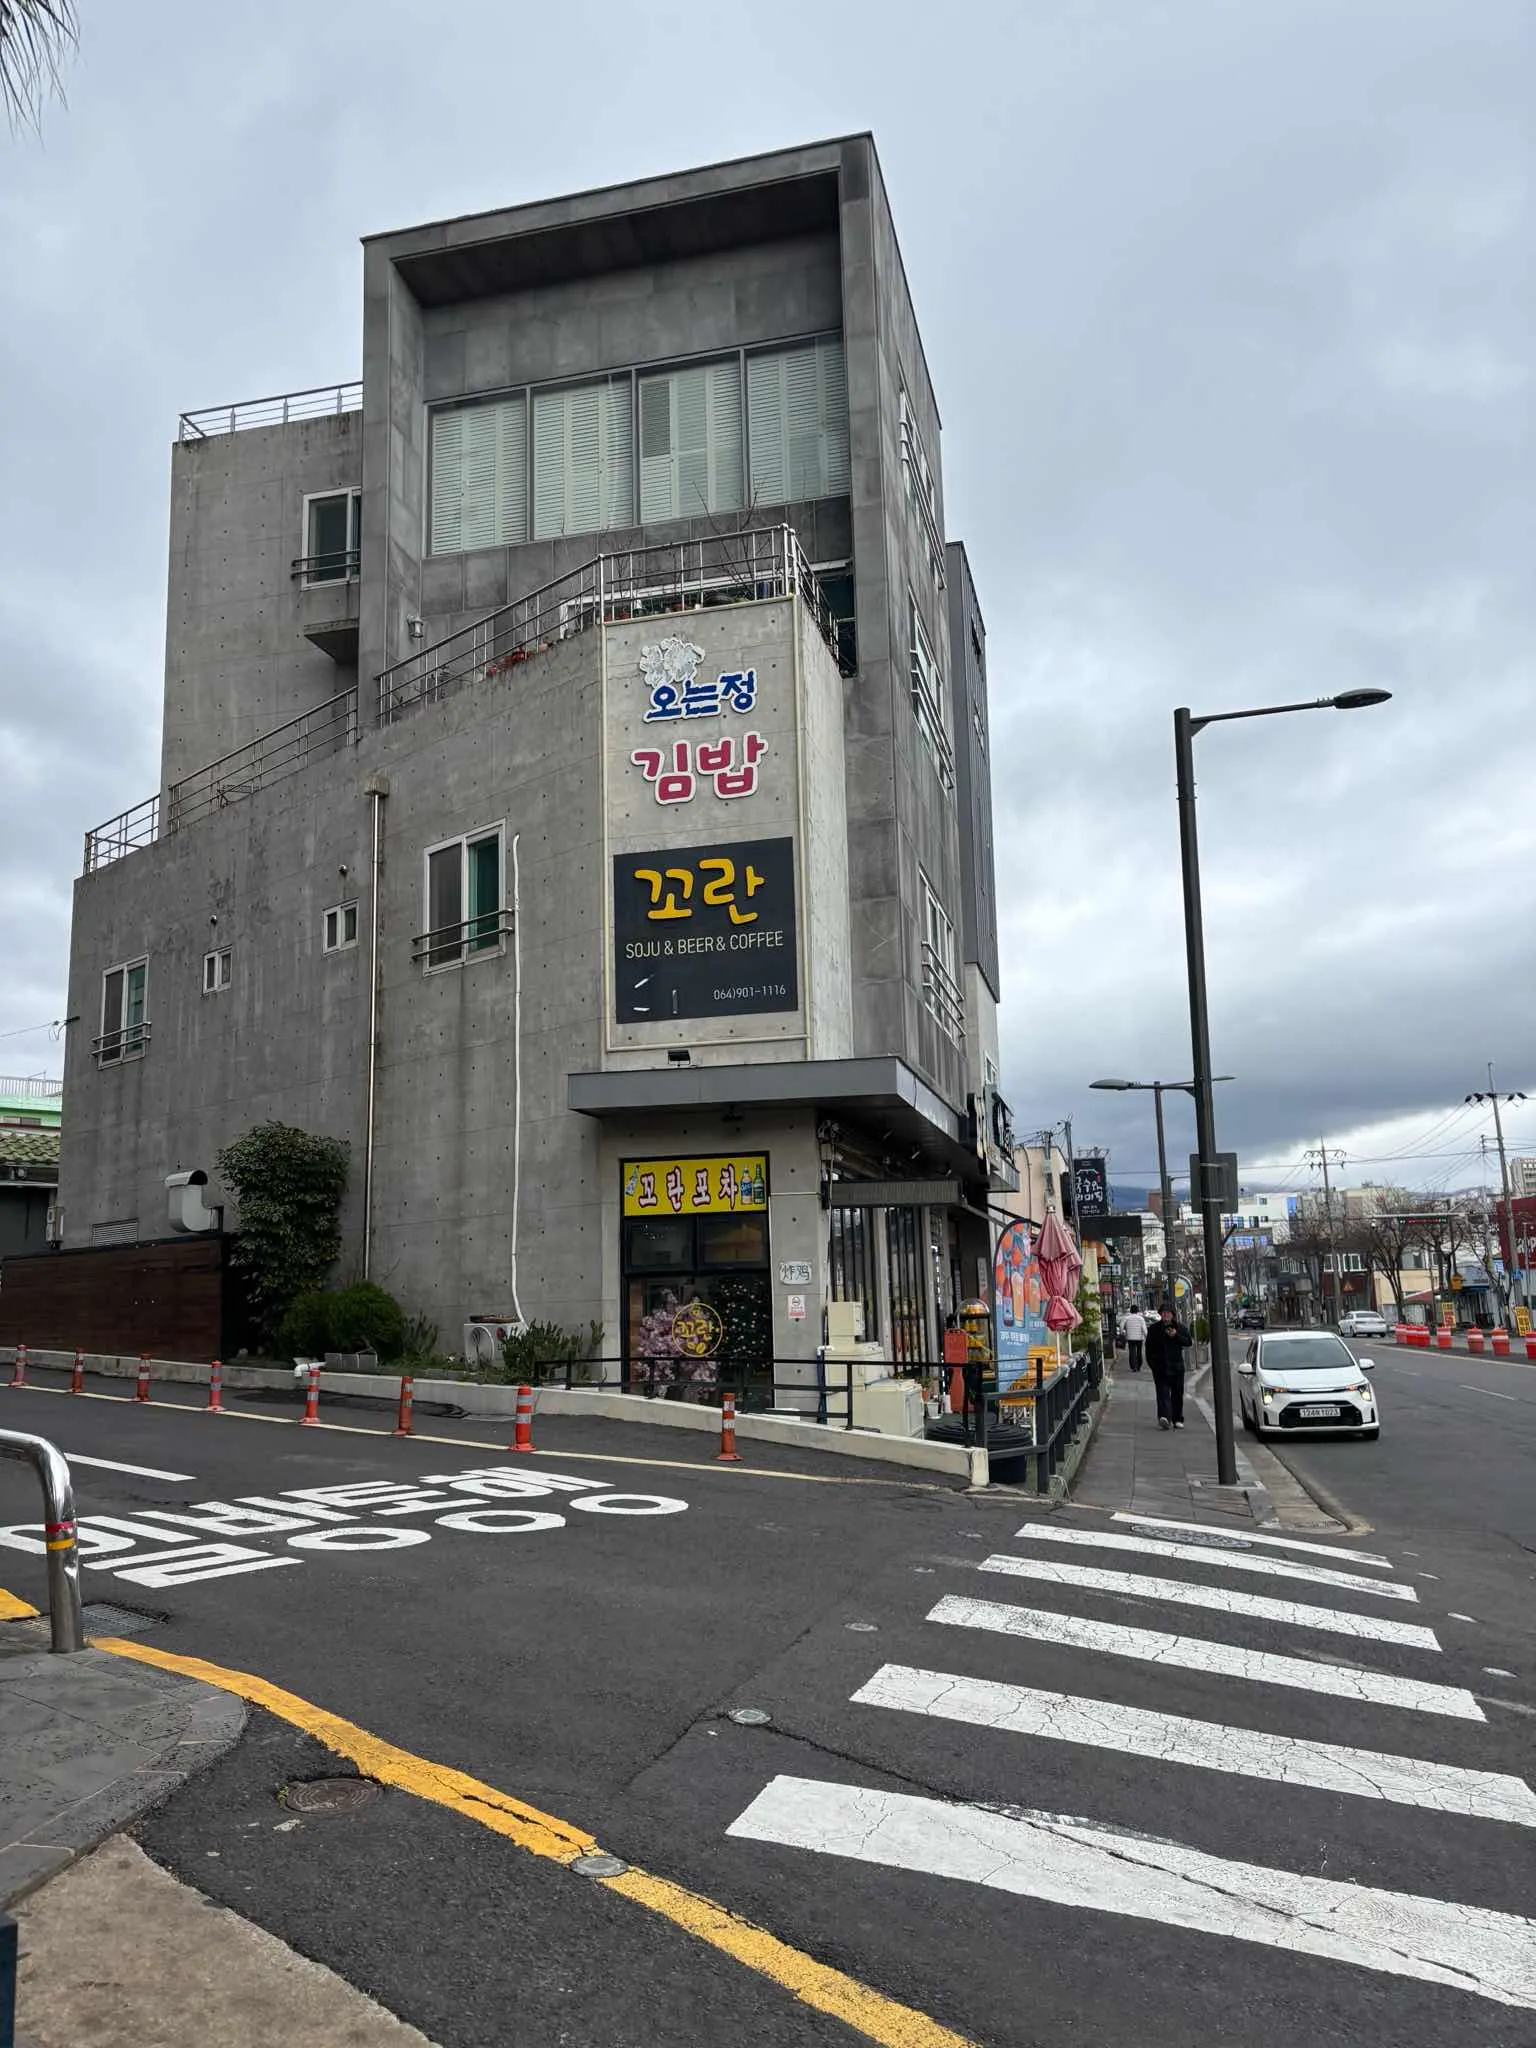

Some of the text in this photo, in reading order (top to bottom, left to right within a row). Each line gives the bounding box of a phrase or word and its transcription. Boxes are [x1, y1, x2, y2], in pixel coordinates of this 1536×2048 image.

[646, 671, 756, 720] 오는정
[633, 733, 767, 803] 김밥
[634, 858, 766, 925] 꼬란
[625, 942, 660, 959] SOJU
[664, 940, 674, 955] &
[678, 936, 714, 955] BEER
[730, 930, 785, 950] COFFEE
[713, 984, 787, 1001] 064)901-1116
[638, 1163, 739, 1213] 꼬란포차
[779, 1264, 810, 1281] 炸鸡
